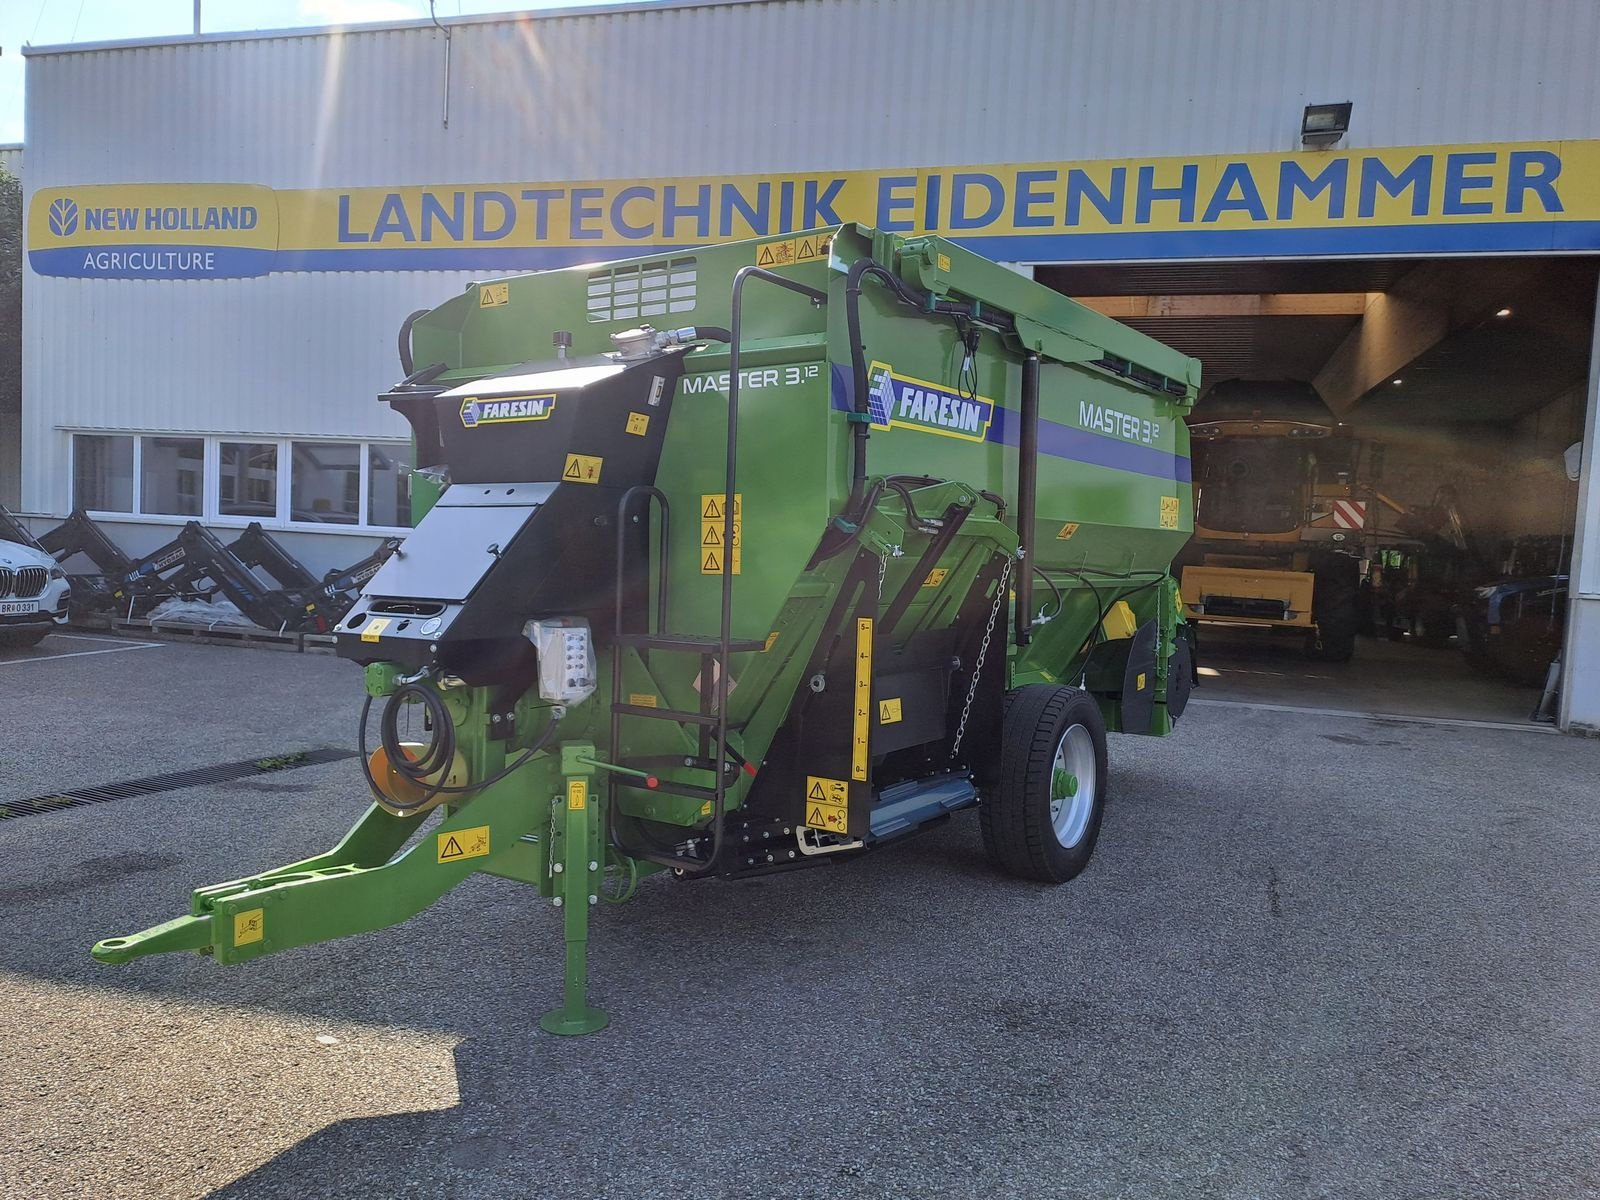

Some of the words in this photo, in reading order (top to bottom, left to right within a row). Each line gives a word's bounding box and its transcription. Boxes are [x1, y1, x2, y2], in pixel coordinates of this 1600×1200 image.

[337, 179, 848, 243] LANDTECHNIK
[876, 150, 1565, 232] EIDENHAMMER
[85, 207, 139, 231] NEW
[145, 206, 258, 230] HOLLAND
[83, 252, 215, 270] AGRICULTURE
[683, 369, 779, 395] MASTER
[483, 400, 545, 419] FARESIN
[899, 386, 981, 433] FARESIN
[1079, 400, 1140, 441] MASTER
